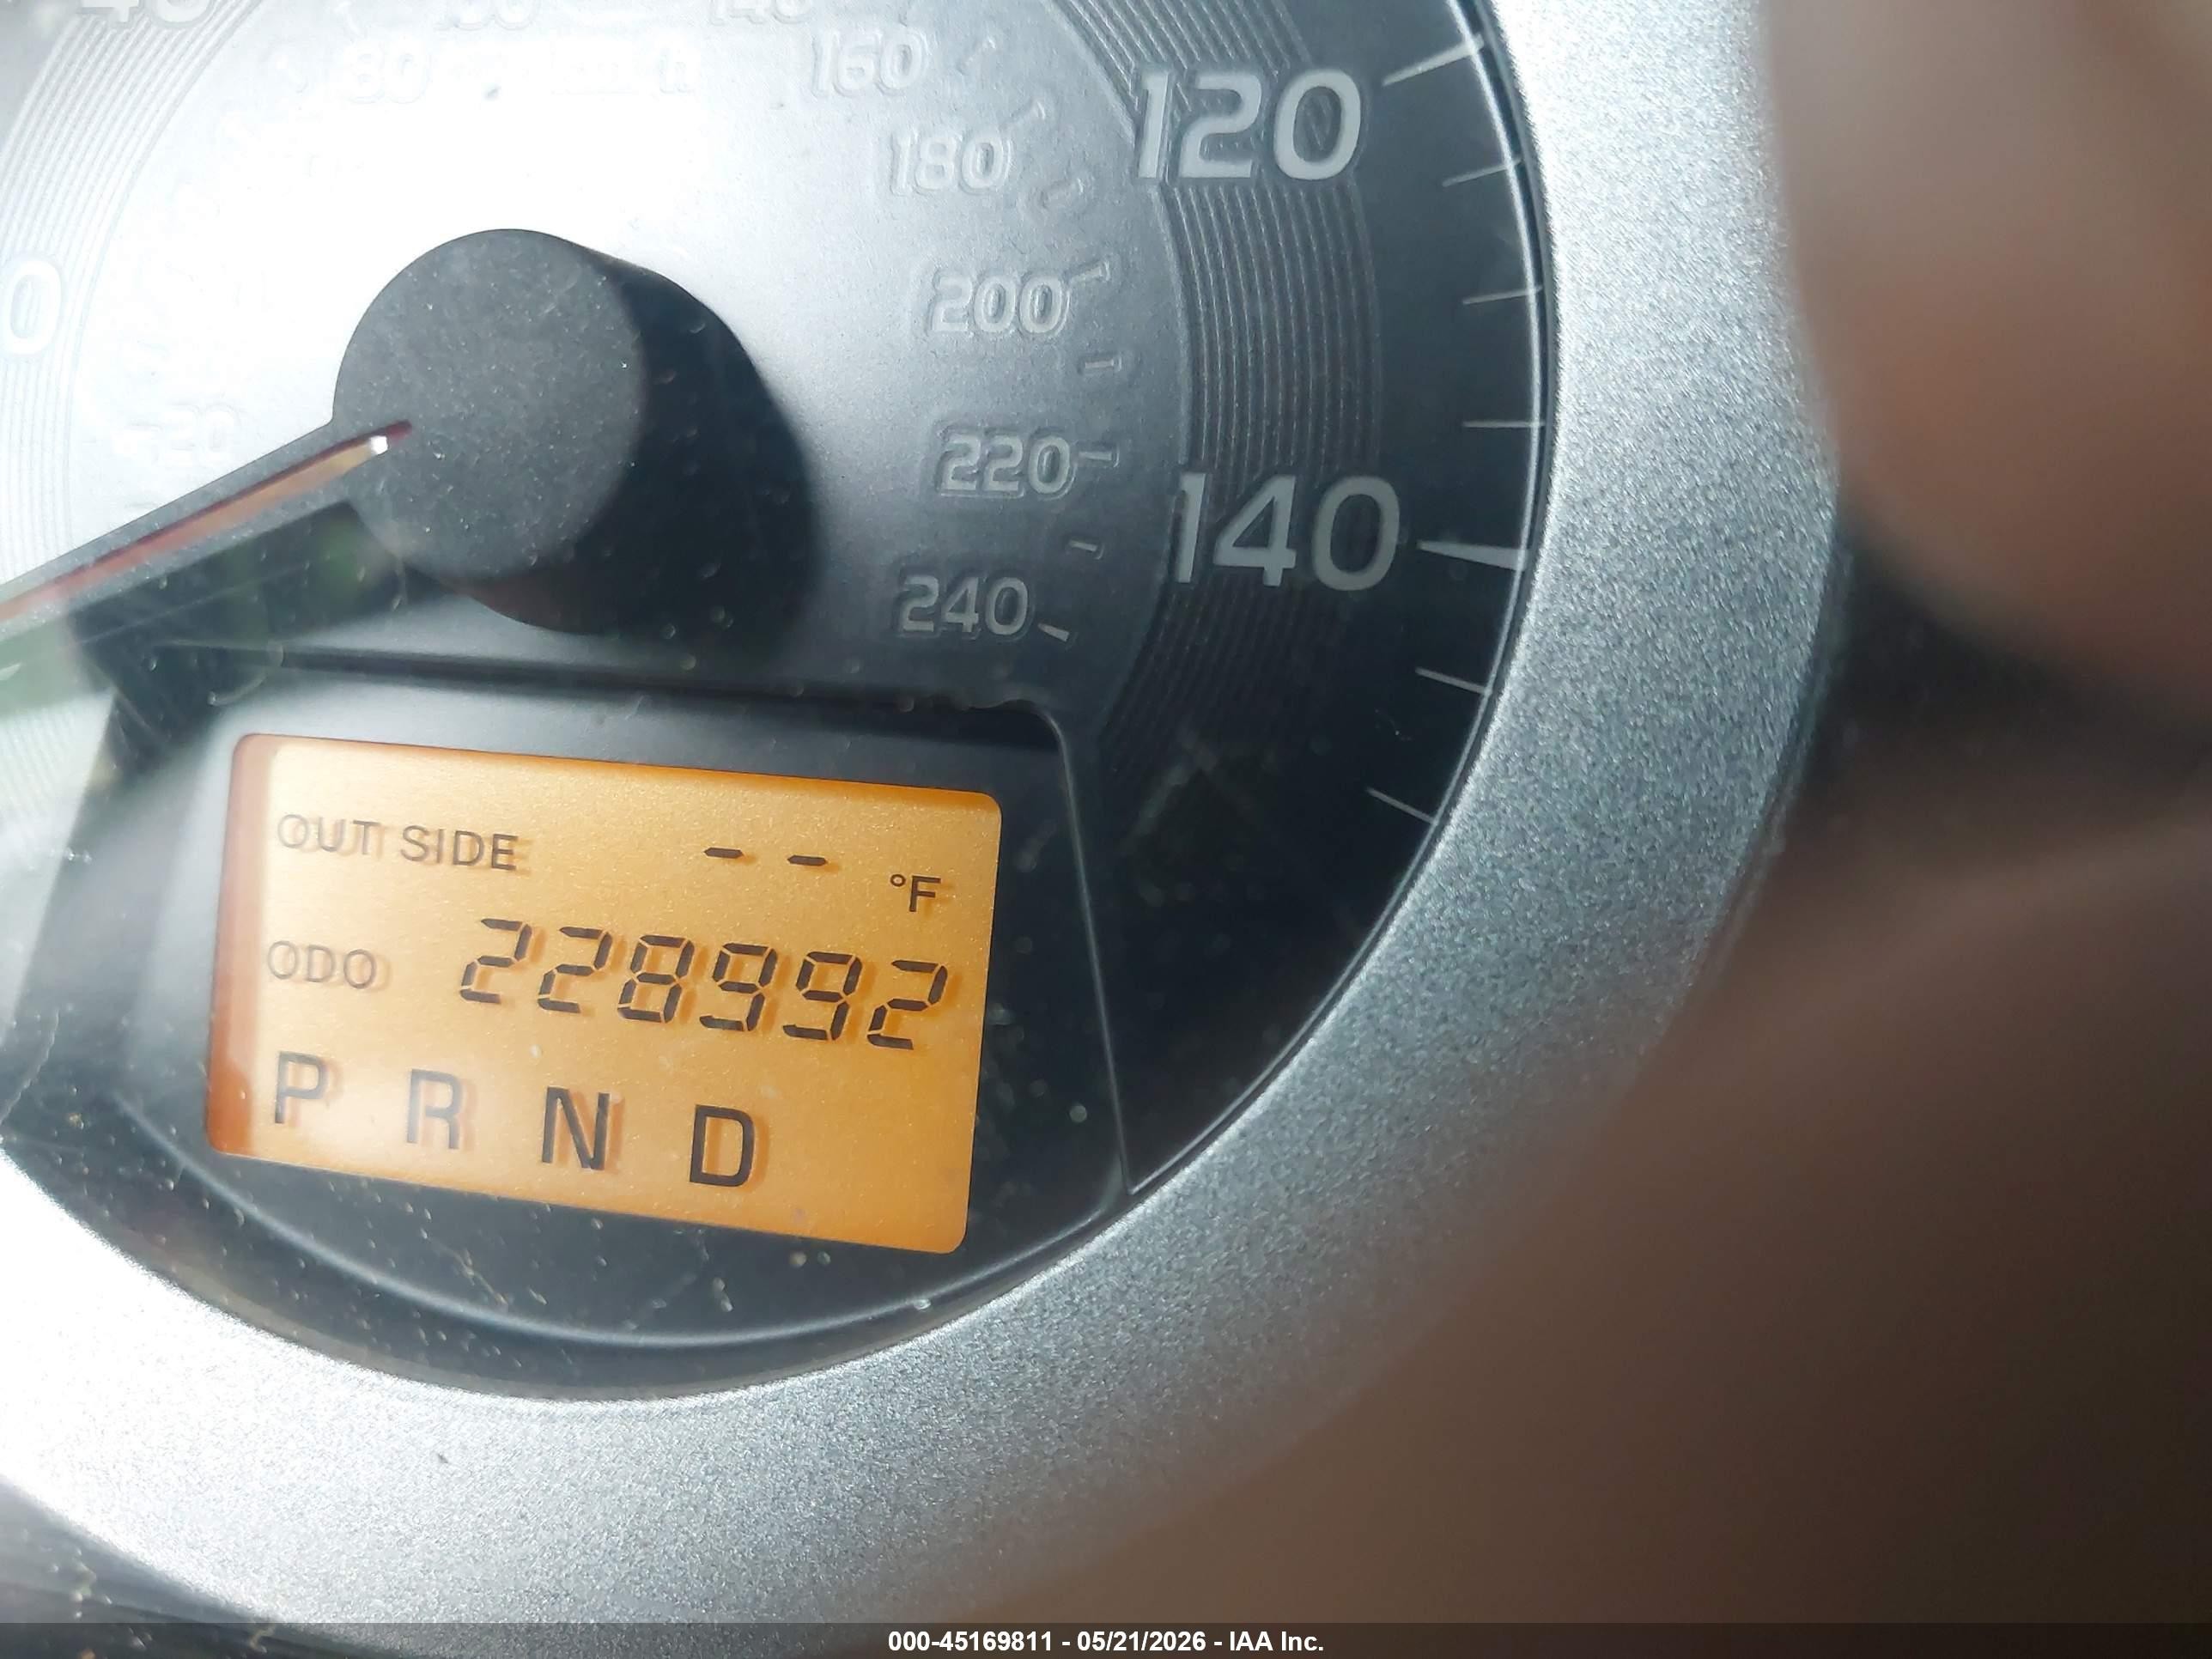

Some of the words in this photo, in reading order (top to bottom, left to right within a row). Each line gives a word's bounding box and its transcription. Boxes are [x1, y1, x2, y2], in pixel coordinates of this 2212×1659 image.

[811, 33, 924, 92] 160
[1137, 68, 1362, 181] 120
[892, 133, 1010, 189] 180
[929, 274, 1067, 334] 200
[941, 435, 1073, 495] 220
[1174, 474, 1401, 591] 140
[900, 574, 1028, 635] 240
[267, 940, 378, 989] ODO
[459, 918, 949, 1050] 228992
[273, 1051, 328, 1125] P
[405, 1069, 462, 1151] R
[541, 1086, 611, 1171] N
[689, 1104, 756, 1188] D
